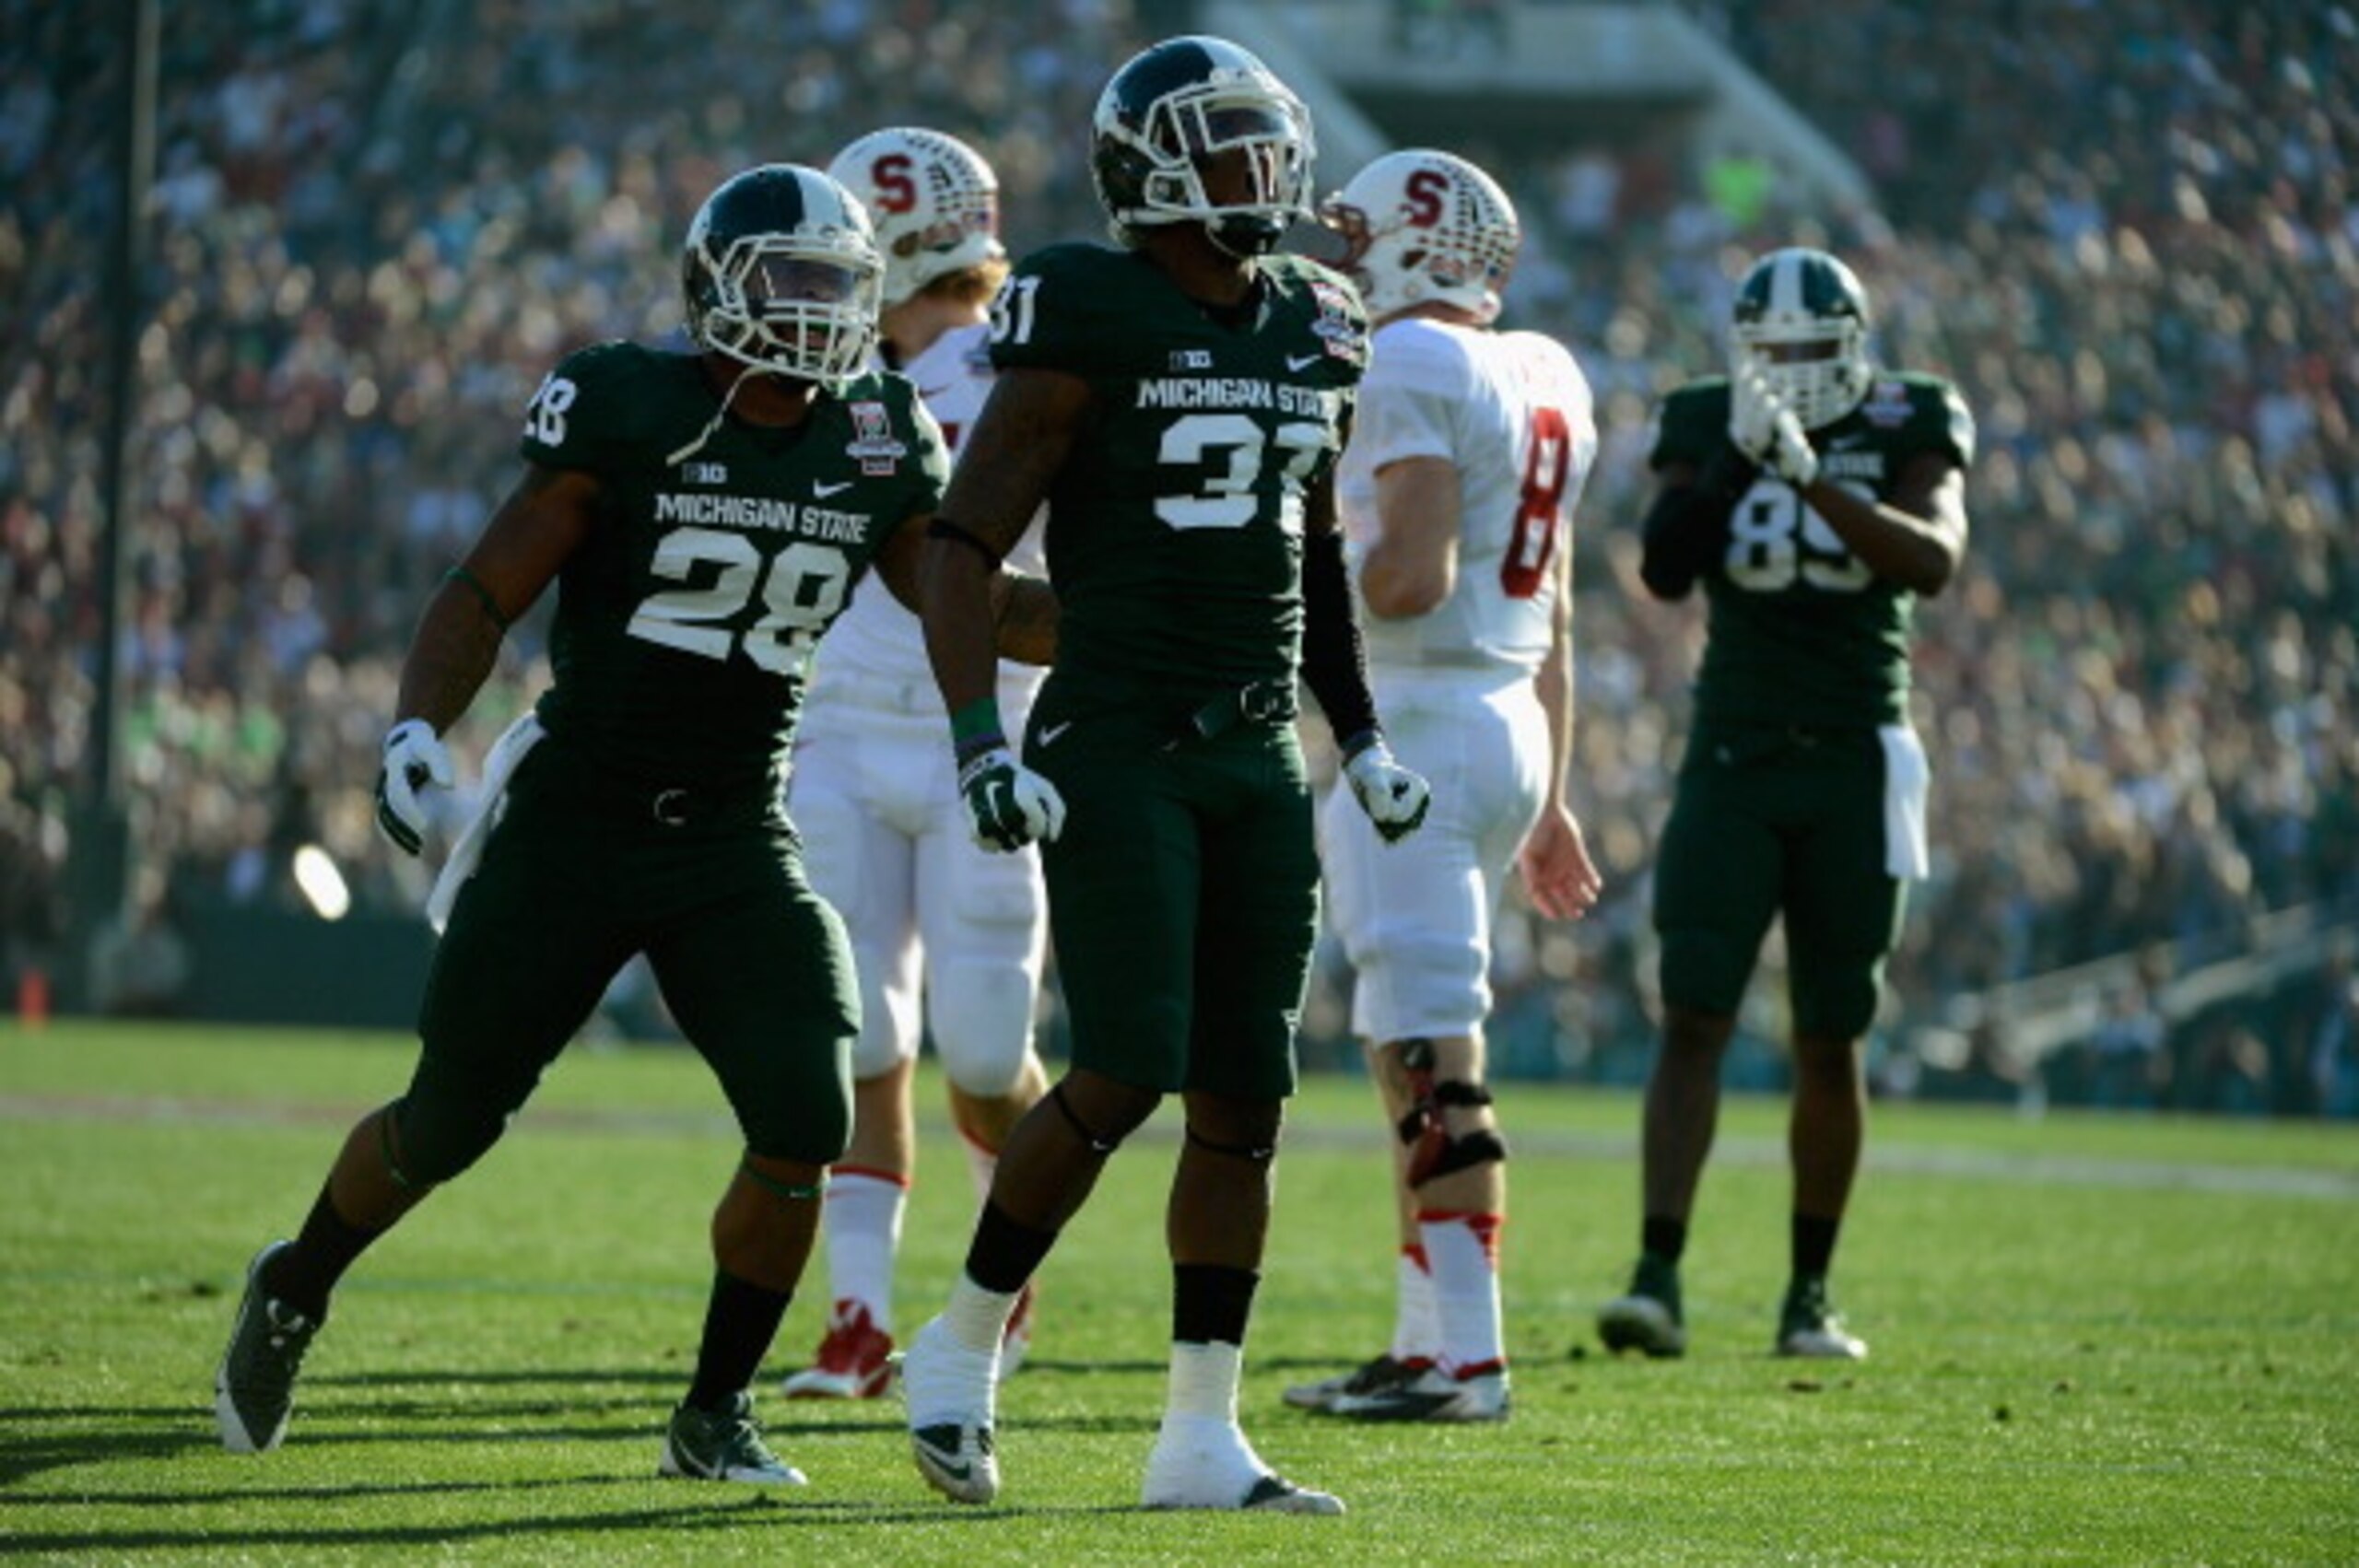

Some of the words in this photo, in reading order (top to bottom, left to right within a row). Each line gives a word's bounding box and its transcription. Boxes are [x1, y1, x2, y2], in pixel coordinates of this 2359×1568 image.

[871, 153, 917, 213] S
[1404, 170, 1449, 228] S
[1136, 378, 1273, 408] MICHIGAN
[654, 493, 796, 532] MICHIGAN
[800, 507, 871, 544] STATE
[1500, 407, 1570, 599] 8
[626, 525, 851, 678] 28
